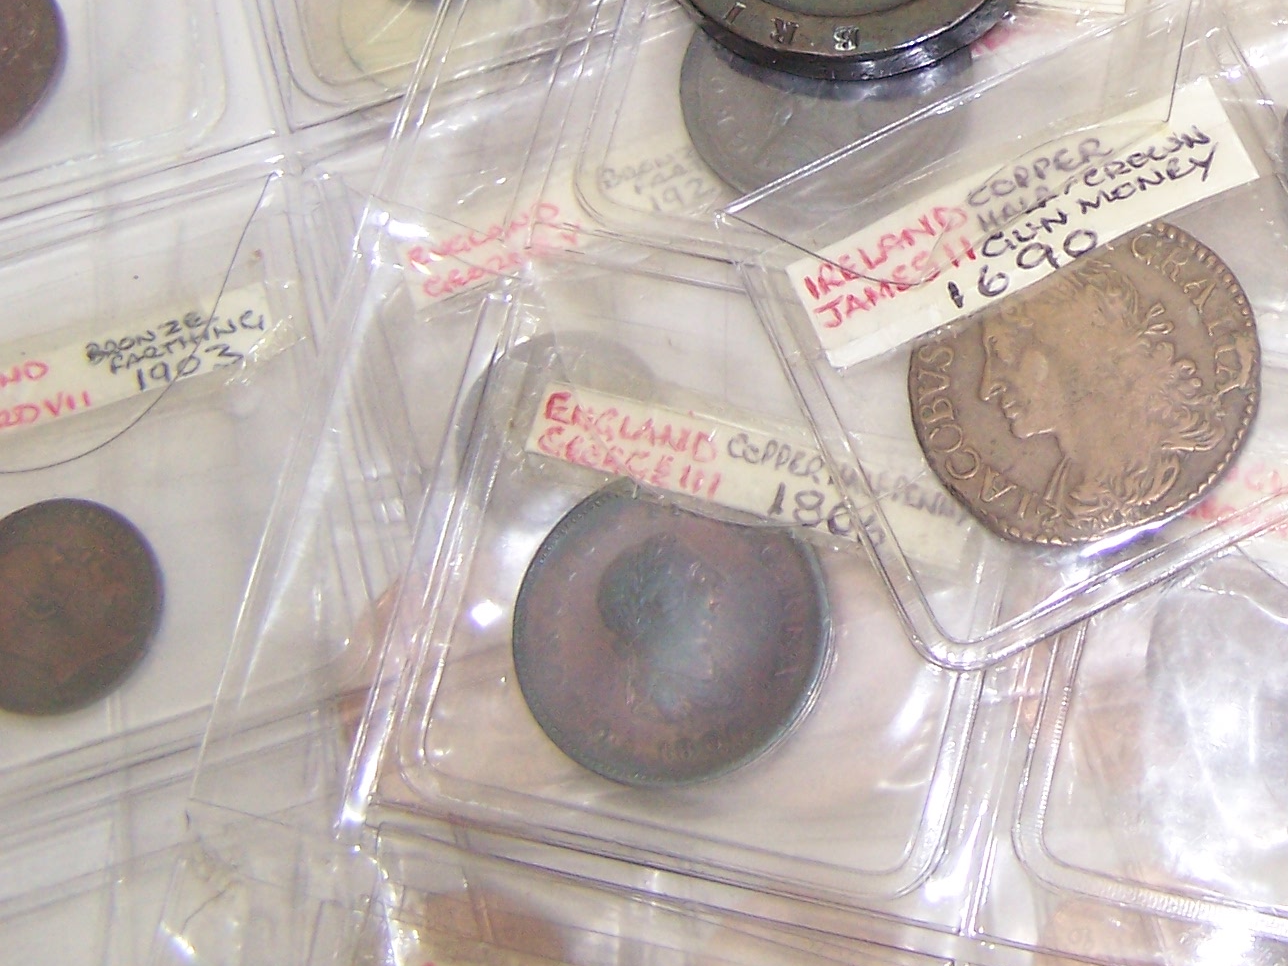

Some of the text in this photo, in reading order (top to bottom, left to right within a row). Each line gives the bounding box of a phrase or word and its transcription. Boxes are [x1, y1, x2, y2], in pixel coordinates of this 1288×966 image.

[964, 136, 1113, 208] COPPER
[803, 204, 969, 302] IRELAND
[813, 247, 942, 330] JAMES
[979, 210, 1068, 260] GUN
[1078, 140, 1219, 216] MONEY
[947, 227, 1101, 309] 1690
[85, 311, 220, 365] BRONZE
[109, 309, 265, 375] FARTHING
[135, 341, 245, 392] 1903
[536, 425, 723, 499] GEORGE III
[543, 390, 718, 465] ENGLAND
